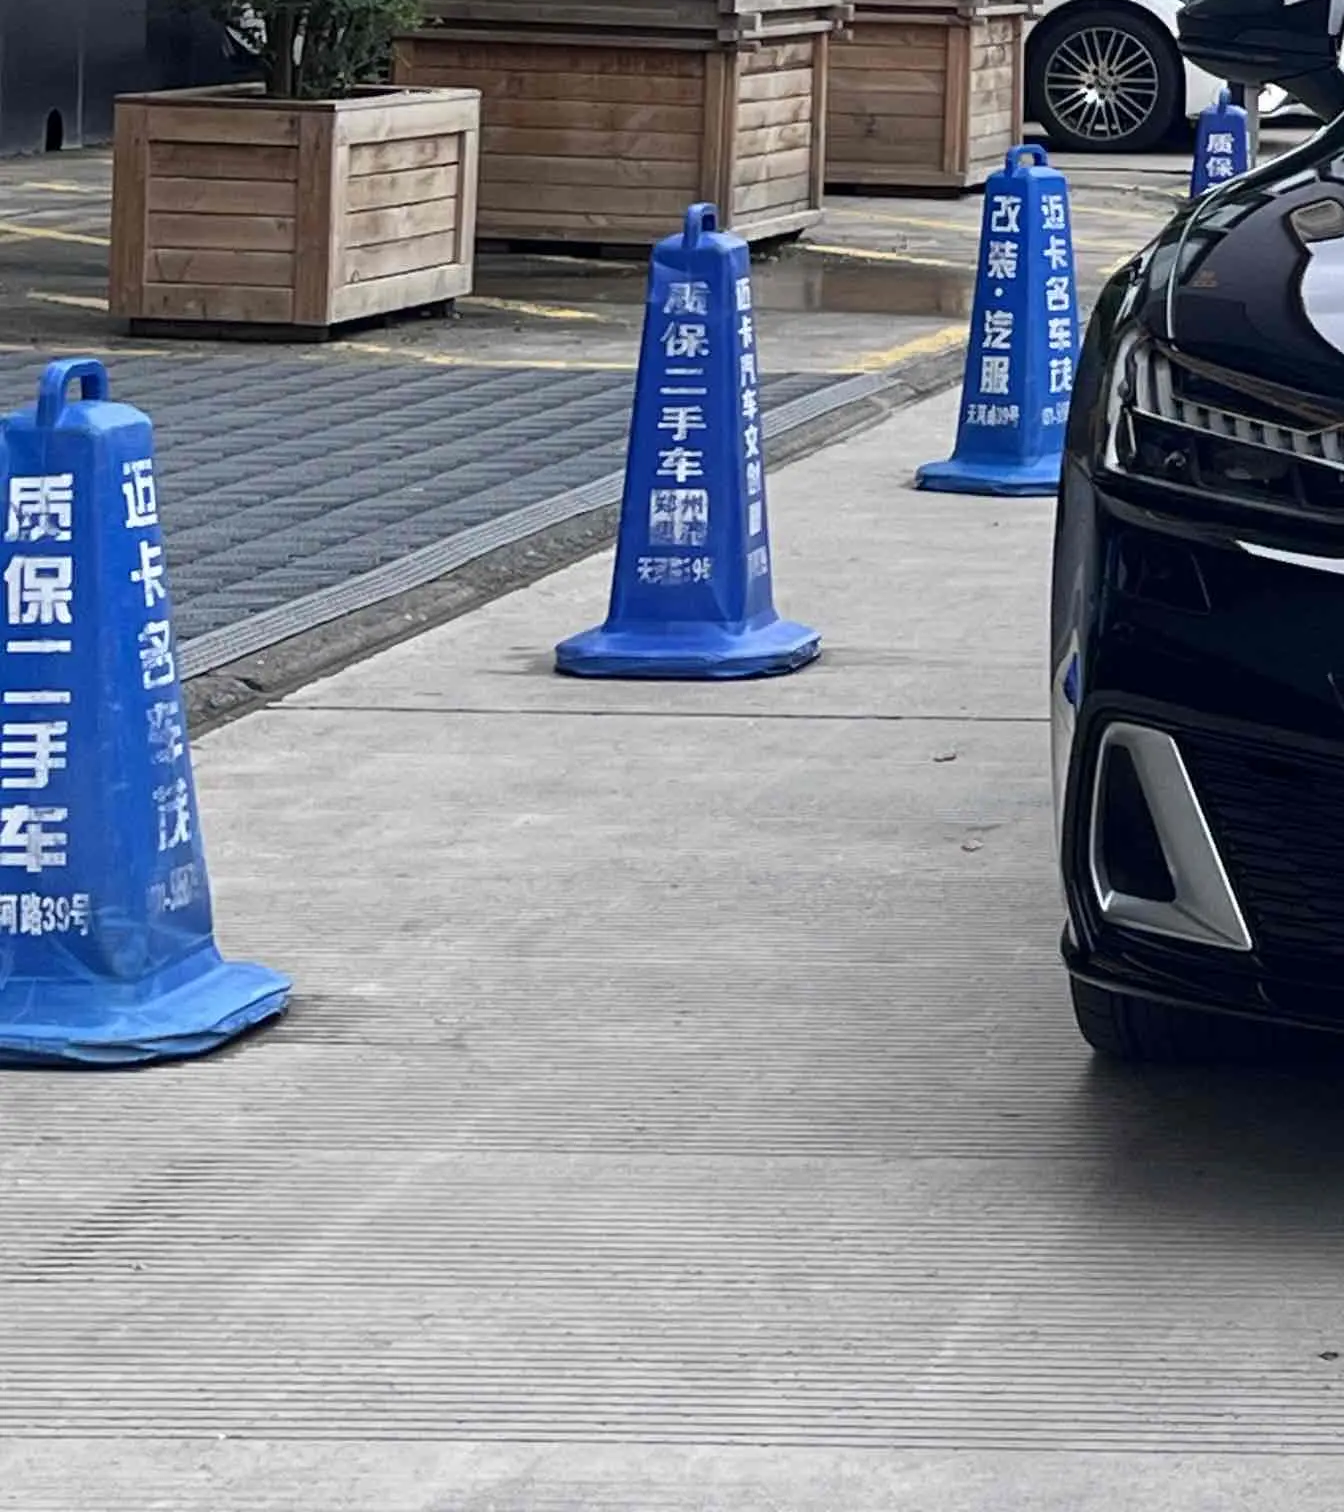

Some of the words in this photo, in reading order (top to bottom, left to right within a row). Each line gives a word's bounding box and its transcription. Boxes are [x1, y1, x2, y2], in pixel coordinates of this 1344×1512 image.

[1205, 133, 1234, 188] 质保
[656, 280, 711, 483] 质保二手车
[0, 472, 75, 873] 质保二手车
